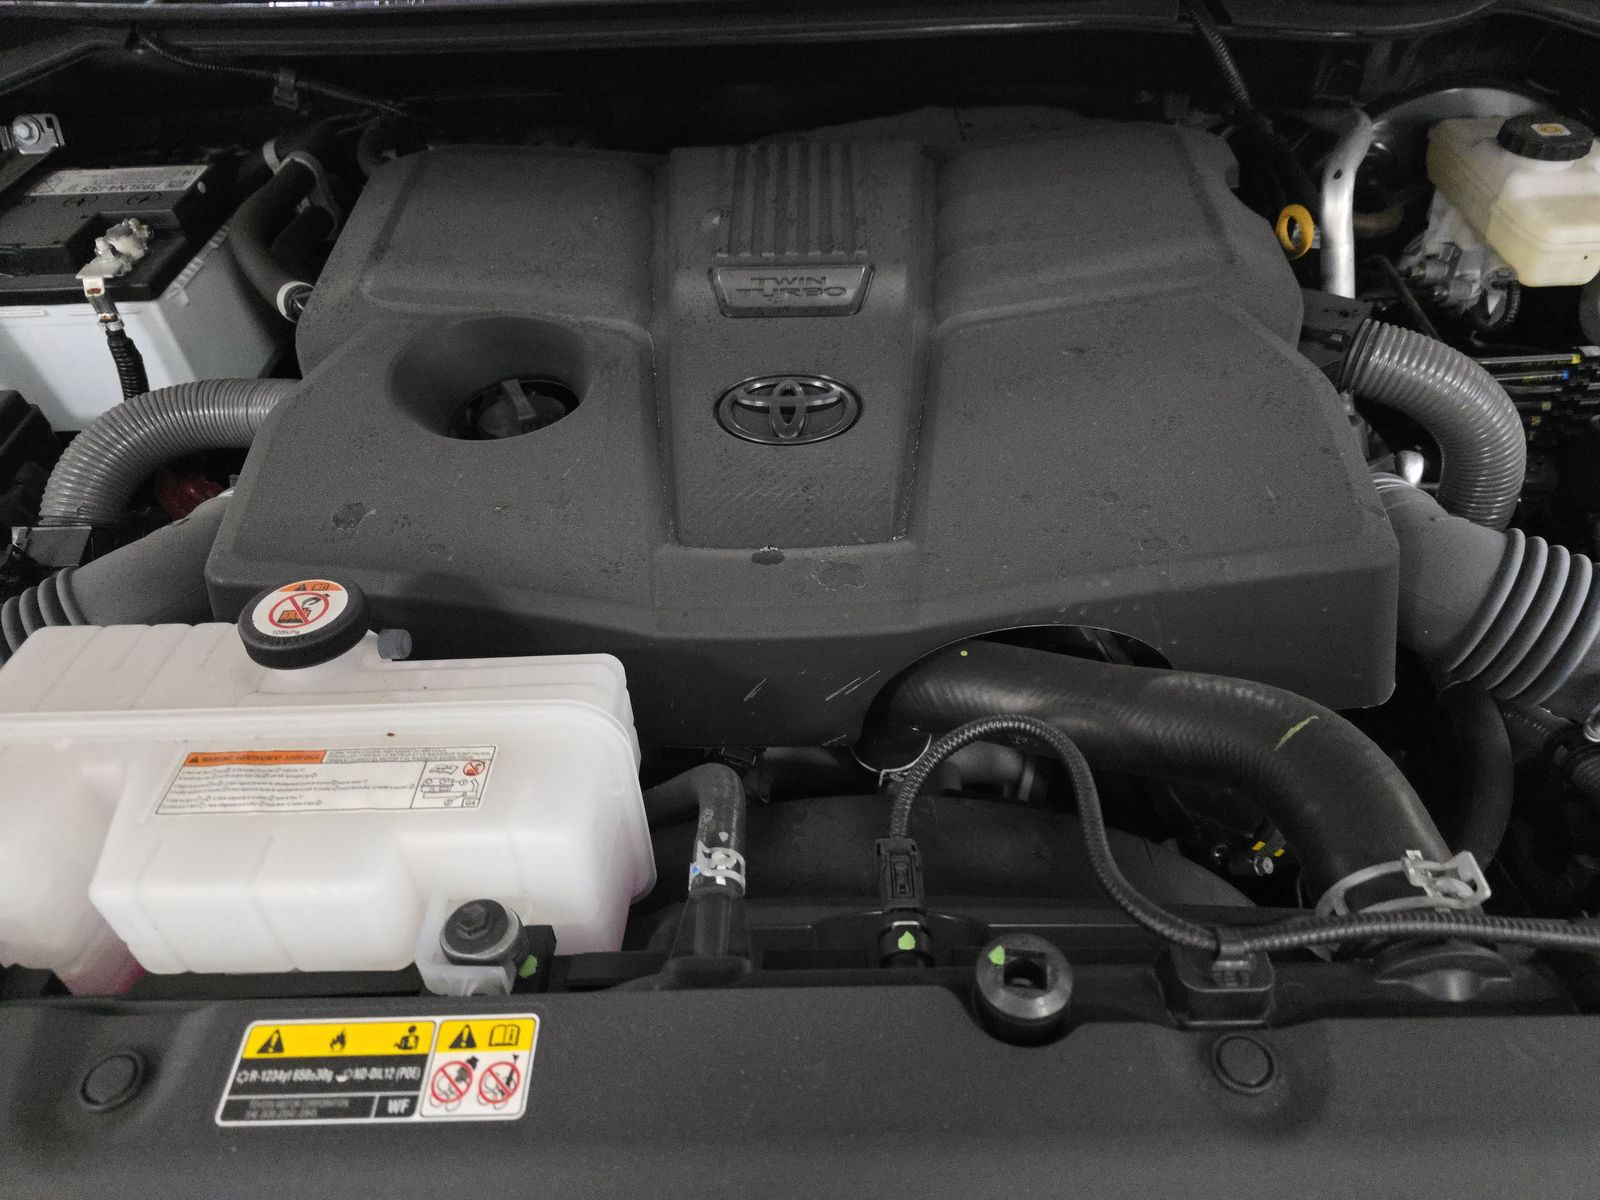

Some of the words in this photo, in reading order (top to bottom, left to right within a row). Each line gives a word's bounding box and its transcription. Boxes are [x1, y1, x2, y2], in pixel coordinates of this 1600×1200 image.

[750, 275, 827, 286] TWIN
[736, 286, 847, 298] TURBO
[387, 1098, 411, 1115] WF
